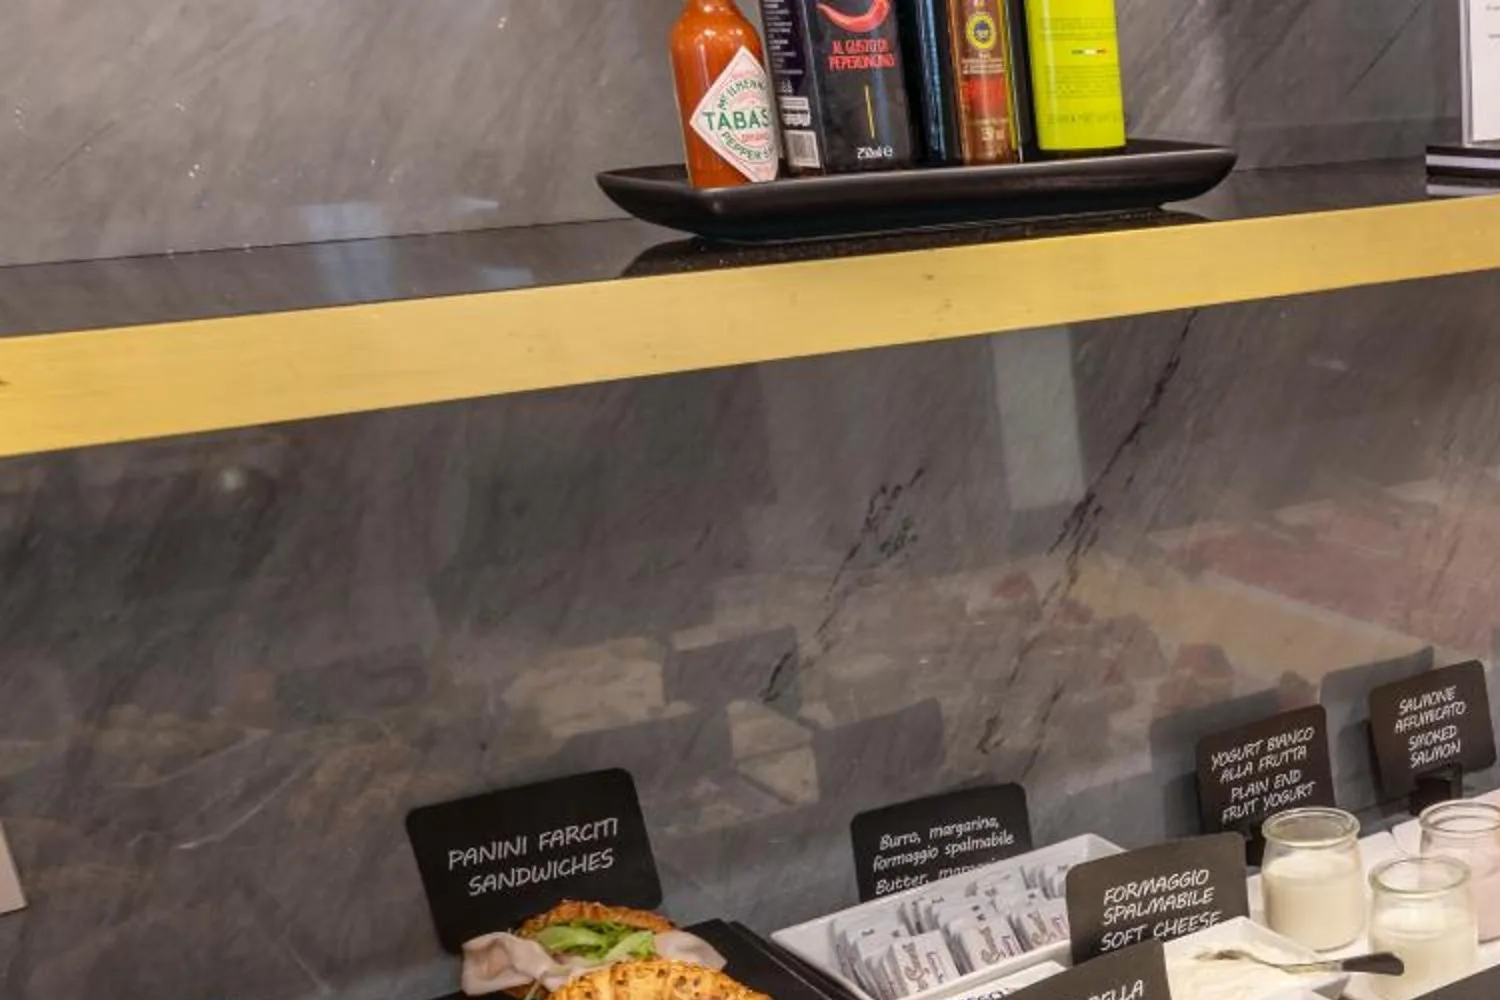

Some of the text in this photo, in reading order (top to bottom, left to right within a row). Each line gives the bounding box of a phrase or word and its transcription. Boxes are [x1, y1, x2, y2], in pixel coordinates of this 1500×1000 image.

[1394, 700, 1467, 735] AFFUMICATO
[1398, 684, 1457, 717] SALMONE
[1211, 726, 1315, 772] YOGURT BIANCO
[1408, 724, 1458, 752] SMOKED
[1410, 738, 1461, 769] SALMON
[1220, 744, 1307, 785] ALLA FRUTTA
[1221, 780, 1316, 825] FRUIT YOGURT
[1231, 769, 1301, 803] PLAIN END
[448, 817, 618, 871] PANINI FARCITI
[873, 844, 939, 872] formaggio
[944, 829, 1015, 858] spalmabile
[879, 831, 921, 851] Burro,
[468, 848, 614, 897] SANDWICHES
[1103, 869, 1210, 906] FORMAGGIO
[1103, 887, 1215, 926] SPALMABILE
[1100, 911, 1223, 952] SOFT CHEESE
